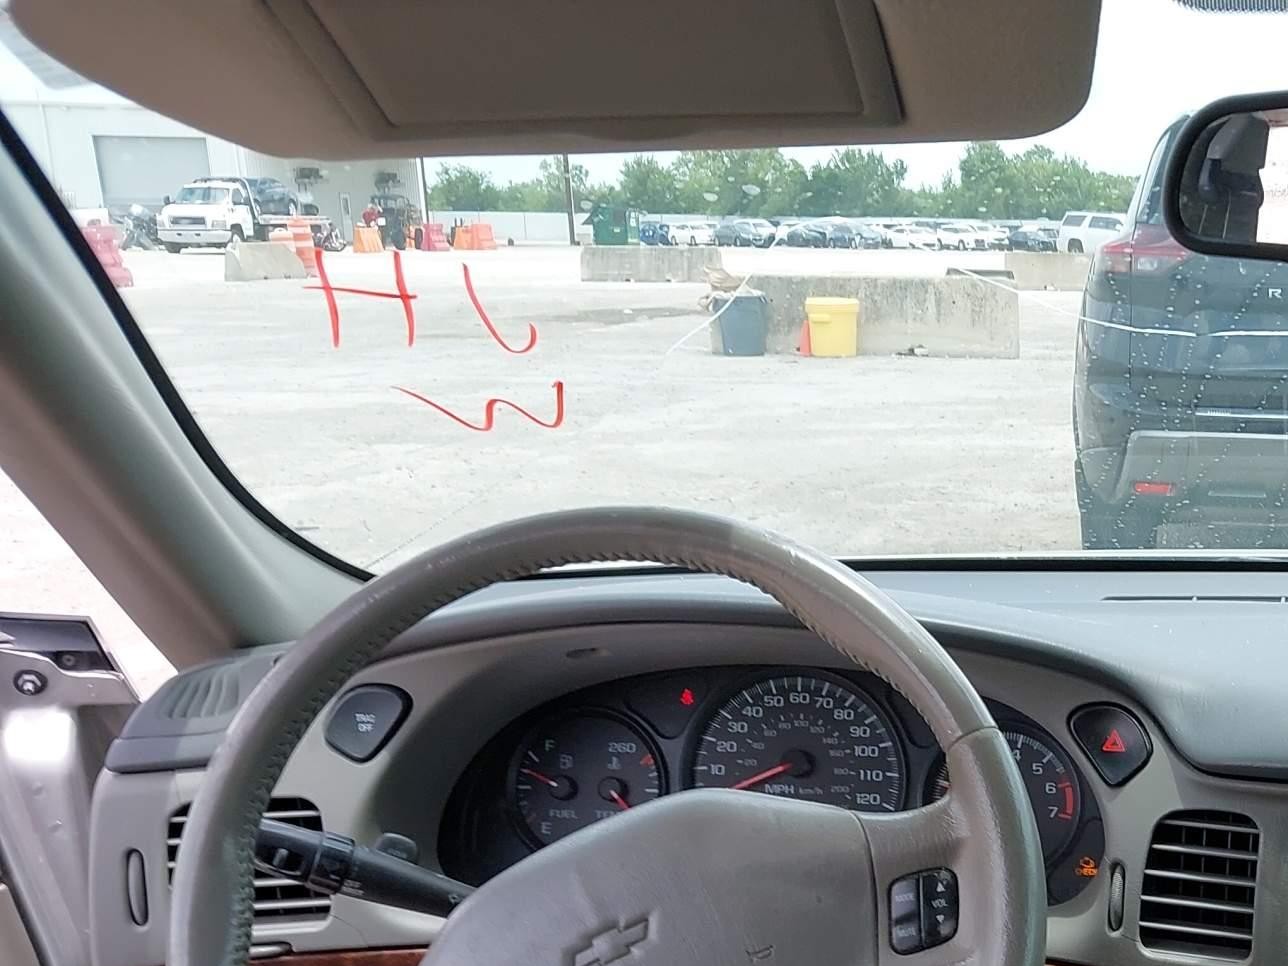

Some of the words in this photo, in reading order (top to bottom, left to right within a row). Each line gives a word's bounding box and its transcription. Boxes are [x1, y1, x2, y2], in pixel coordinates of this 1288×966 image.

[763, 695, 785, 707] 50
[789, 692, 811, 704] 60
[814, 697, 834, 709] 70
[741, 706, 764, 718] 40
[833, 709, 855, 721] 80
[727, 721, 748, 733] 30
[849, 726, 871, 738] 90
[545, 740, 556, 751] F
[608, 742, 637, 753] 260
[716, 740, 737, 752] 20
[854, 745, 879, 757] 100
[710, 763, 726, 776] 10
[1032, 762, 1044, 775] 5
[859, 769, 884, 782] 110
[764, 784, 795, 795] MPH
[1045, 782, 1057, 794] 6
[856, 792, 881, 805] 120
[549, 809, 579, 819] FUEL
[1047, 806, 1059, 819] 7
[541, 822, 552, 835] E
